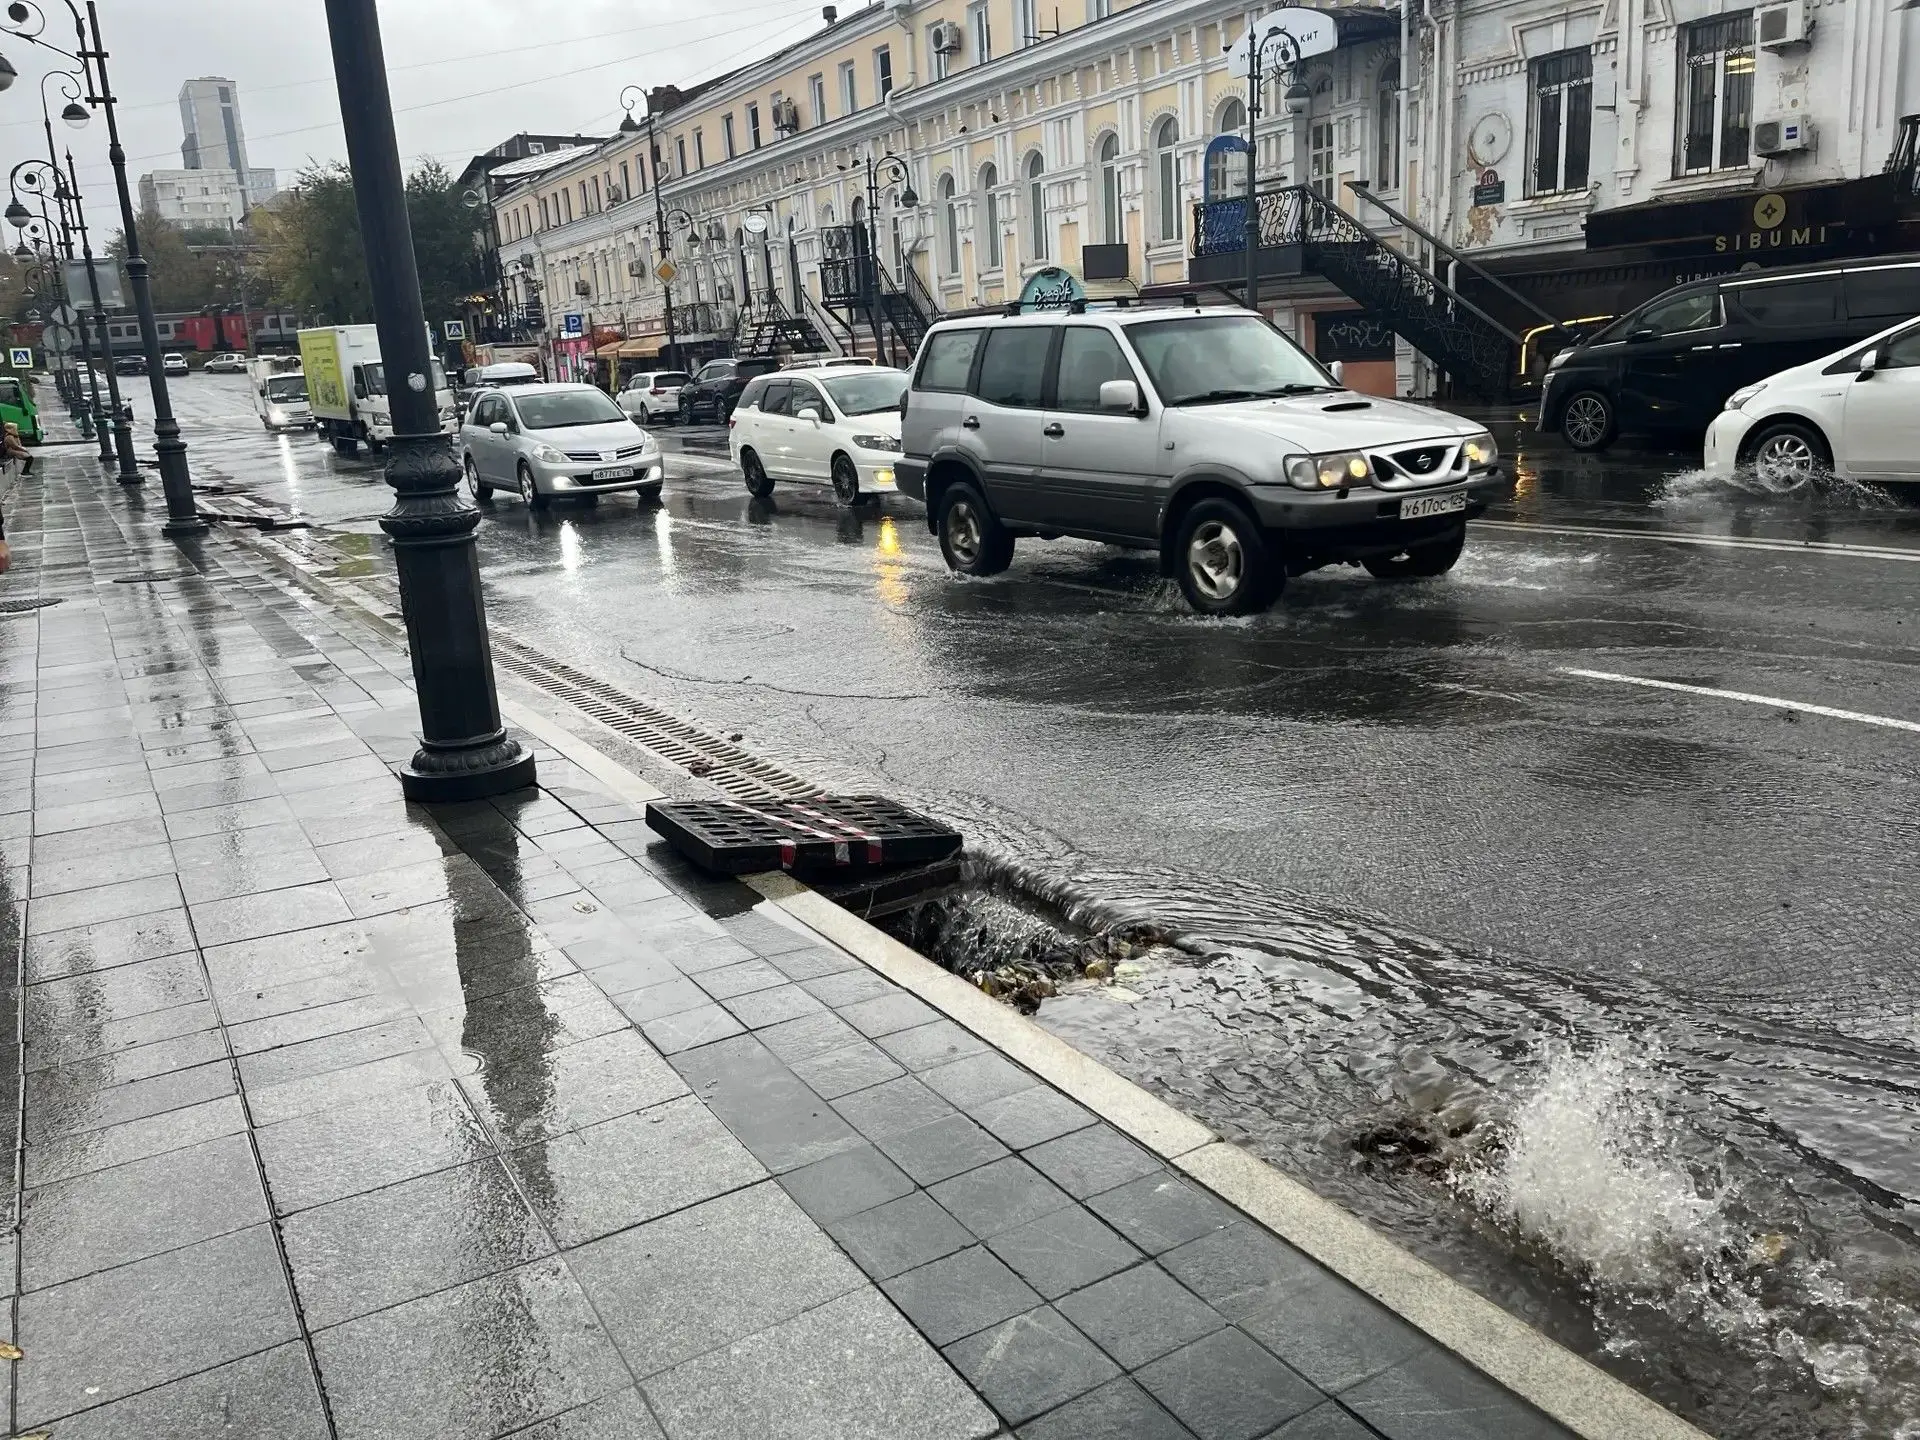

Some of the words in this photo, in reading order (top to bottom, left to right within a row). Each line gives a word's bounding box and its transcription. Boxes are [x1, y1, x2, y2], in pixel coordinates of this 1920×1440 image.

[1300, 30, 1318, 43] КИТ
[1483, 173, 1495, 186] 10
[1715, 226, 1826, 251] SIBUMI
